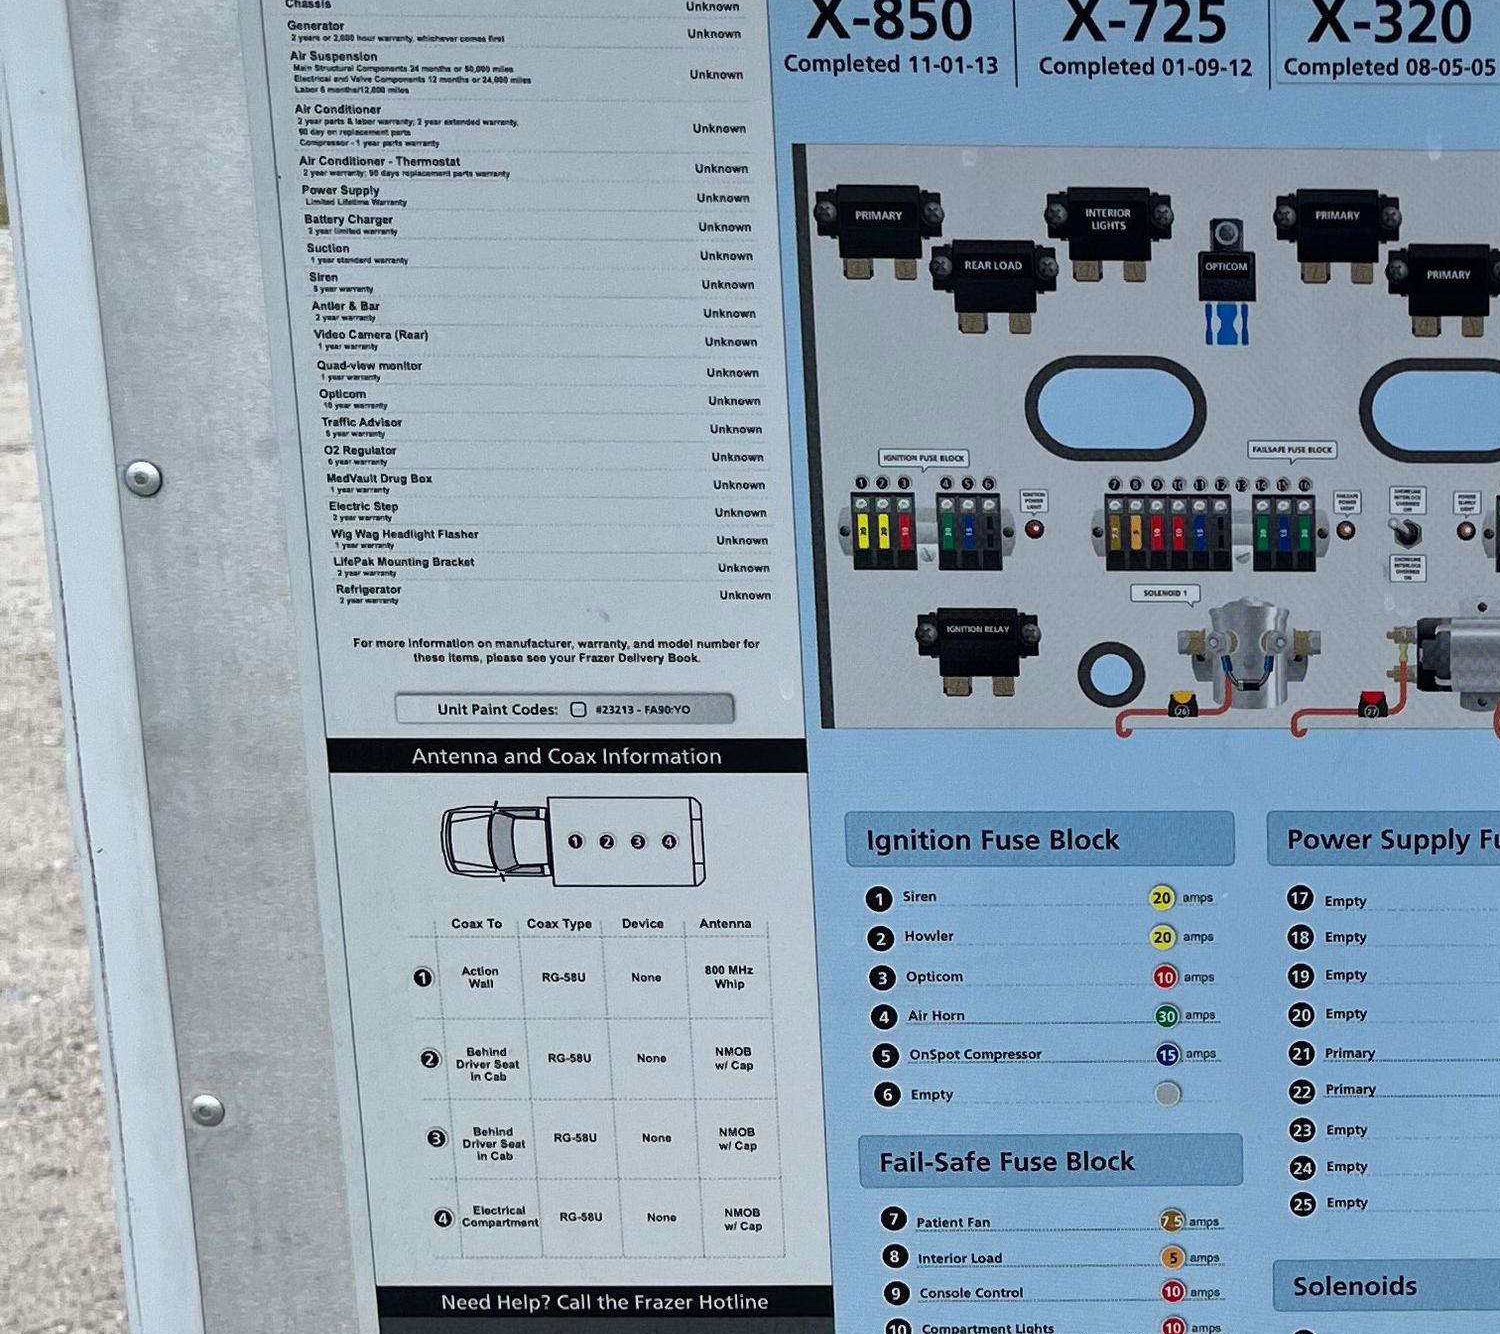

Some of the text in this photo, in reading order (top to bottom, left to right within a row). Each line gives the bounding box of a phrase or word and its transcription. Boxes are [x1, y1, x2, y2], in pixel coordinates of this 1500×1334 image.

[686, 1, 740, 12] Unknown
[289, 50, 744, 80] Air Suspension Unknown
[784, 53, 999, 77] Completed 11-01-13
[1039, 55, 1253, 80] Completed 01-09-12
[1284, 56, 1496, 81] Completed 08-05-05
[855, 210, 903, 221] PRIMARY
[1085, 208, 1131, 218] INTERIOR
[1315, 210, 1361, 220] PRIMARY
[1091, 220, 1127, 231] LIGHTS
[964, 260, 1023, 271] REAR LOAD
[1205, 262, 1248, 271] OPTICOM
[1426, 270, 1471, 280] PRIMARY
[313, 329, 758, 347] Video Camera (Rear) Unknown
[437, 703, 469, 716] Unit
[471, 703, 509, 716] Paint
[511, 703, 558, 716] Codes:
[411, 747, 722, 765] Antenna and Coax Information
[868, 827, 1121, 855] Ignition Fuse Block
[1288, 829, 1373, 850] Power
[1382, 828, 1470, 855] Supply
[875, 890, 1214, 906] 1 Siren 20 amps
[451, 917, 503, 929] Coax To
[526, 918, 592, 932] Coax Type
[621, 918, 664, 929] Device
[699, 918, 752, 929] Antenna
[704, 964, 754, 976] 800 MHz
[542, 972, 586, 983] RG-58U
[631, 972, 662, 983] None
[1292, 1047, 1310, 1061] 21
[1325, 1047, 1376, 1063] Primary
[880, 1149, 1136, 1173] Fail-Safe Fuse Block
[1293, 1274, 1417, 1297] Solenoids
[441, 1293, 769, 1314] Need Help? Call the Frazer Hotline
[1165, 1322, 1182, 1334] 10
